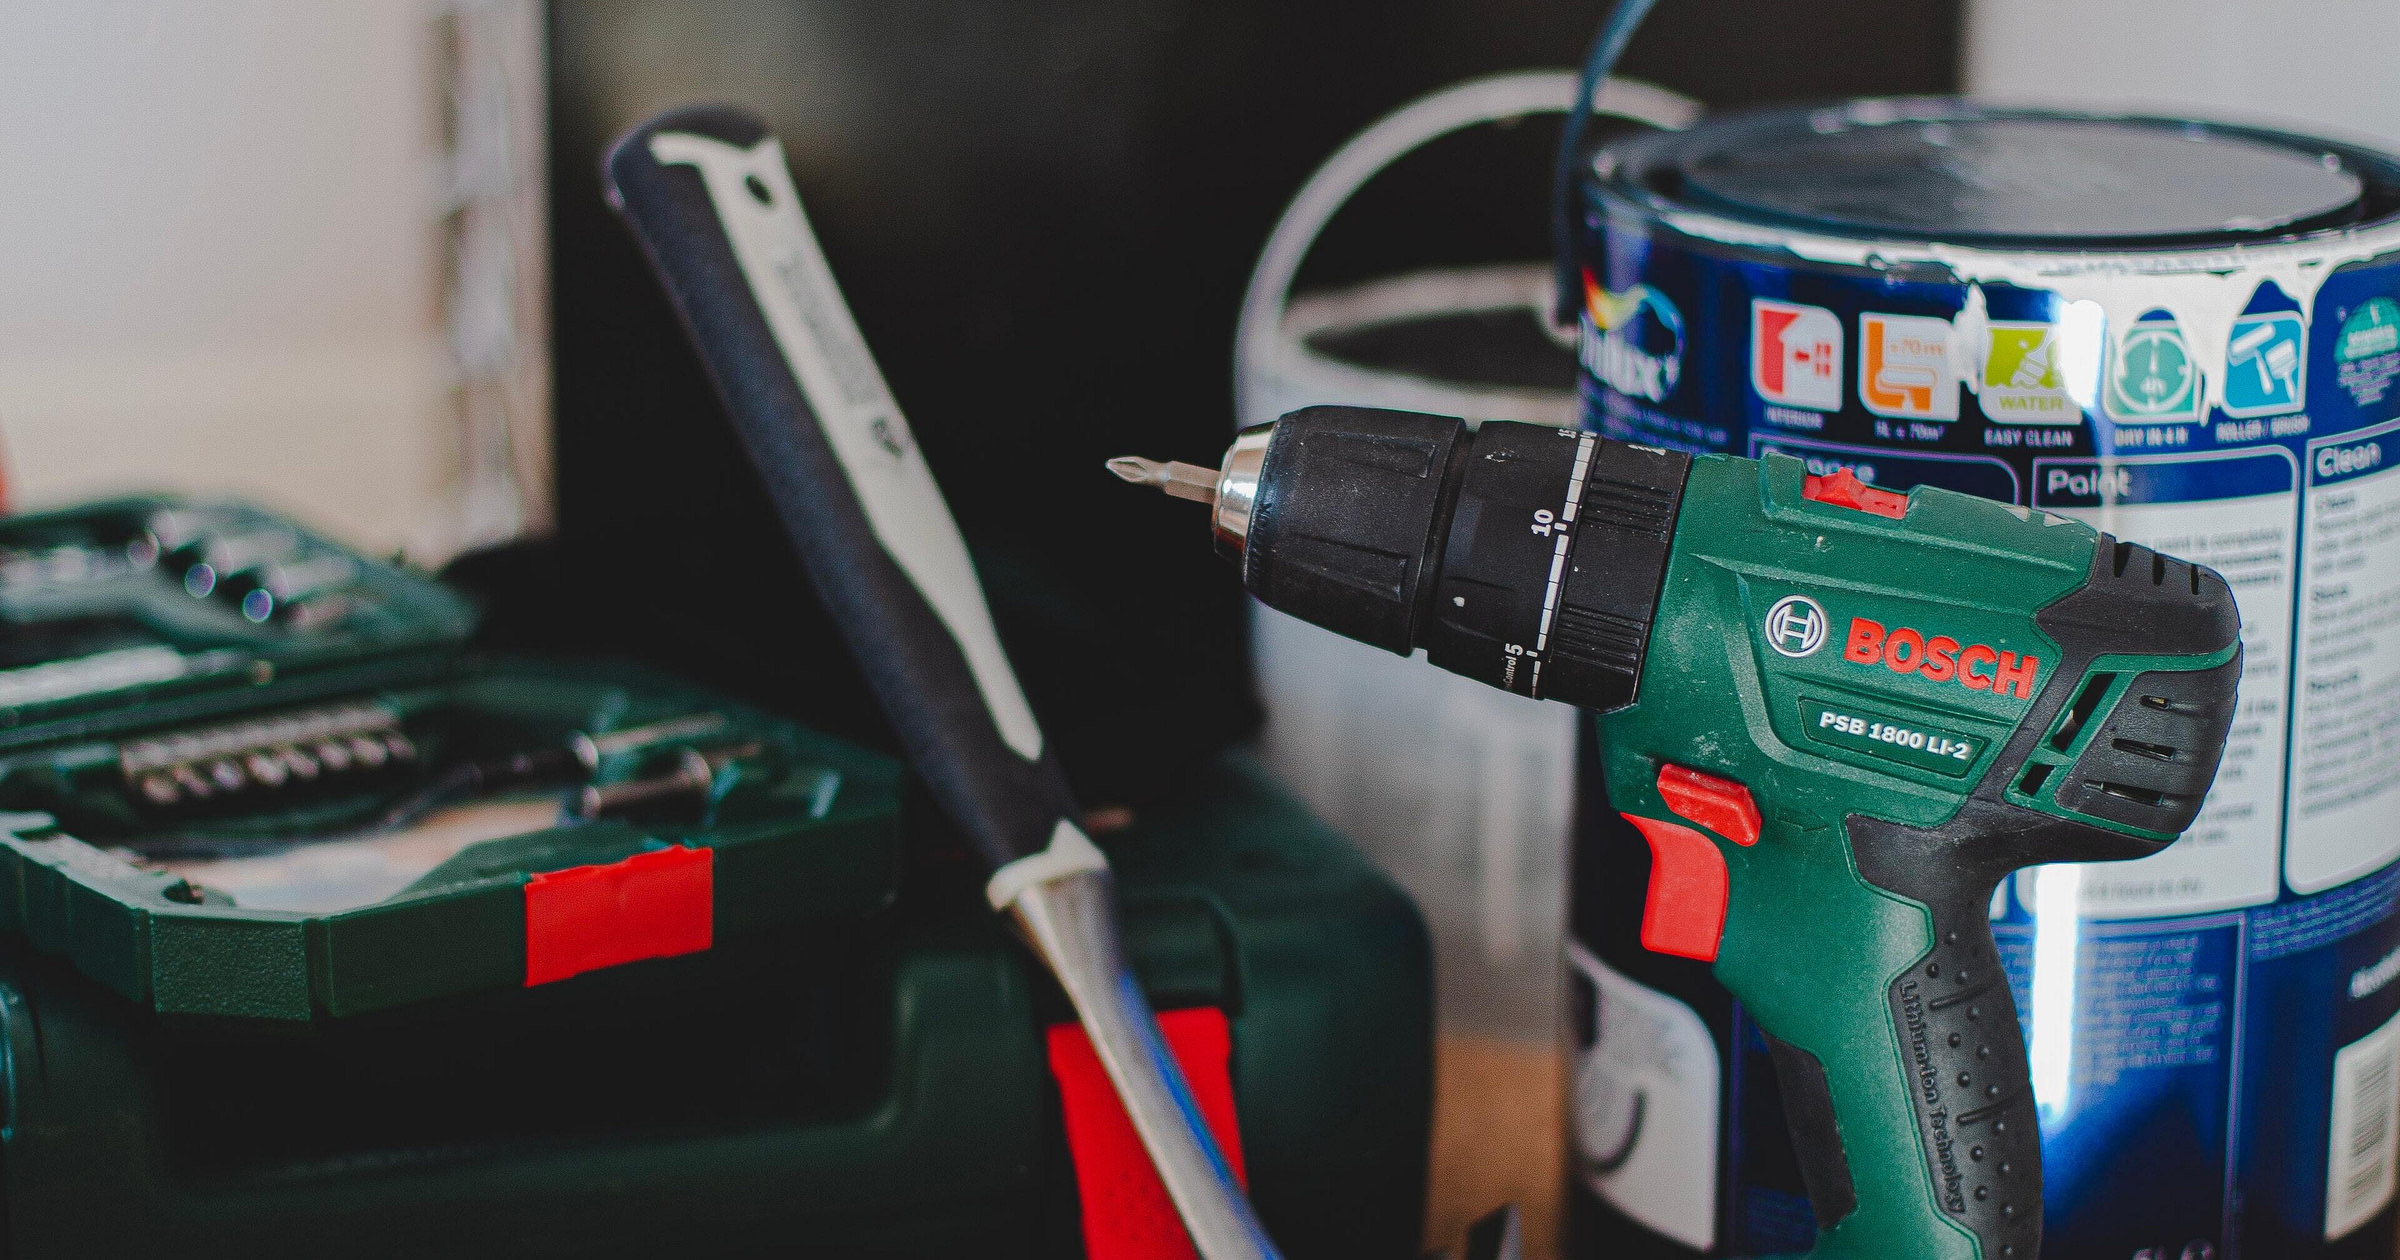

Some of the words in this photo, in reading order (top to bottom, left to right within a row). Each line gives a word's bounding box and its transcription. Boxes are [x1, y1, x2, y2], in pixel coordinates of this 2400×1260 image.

[1999, 397, 2064, 411] WATER
[1984, 429, 2021, 446] EASY
[2025, 429, 2073, 446] CLEAN
[2317, 443, 2381, 477] Clean
[2048, 468, 2130, 496] Paint
[1531, 509, 1554, 537] 10
[1505, 643, 1523, 656] 5
[1843, 617, 2039, 700] BOSCH
[1819, 711, 1868, 735] PSB
[1869, 722, 1927, 750] 1800
[1926, 736, 1971, 760] LI-2
